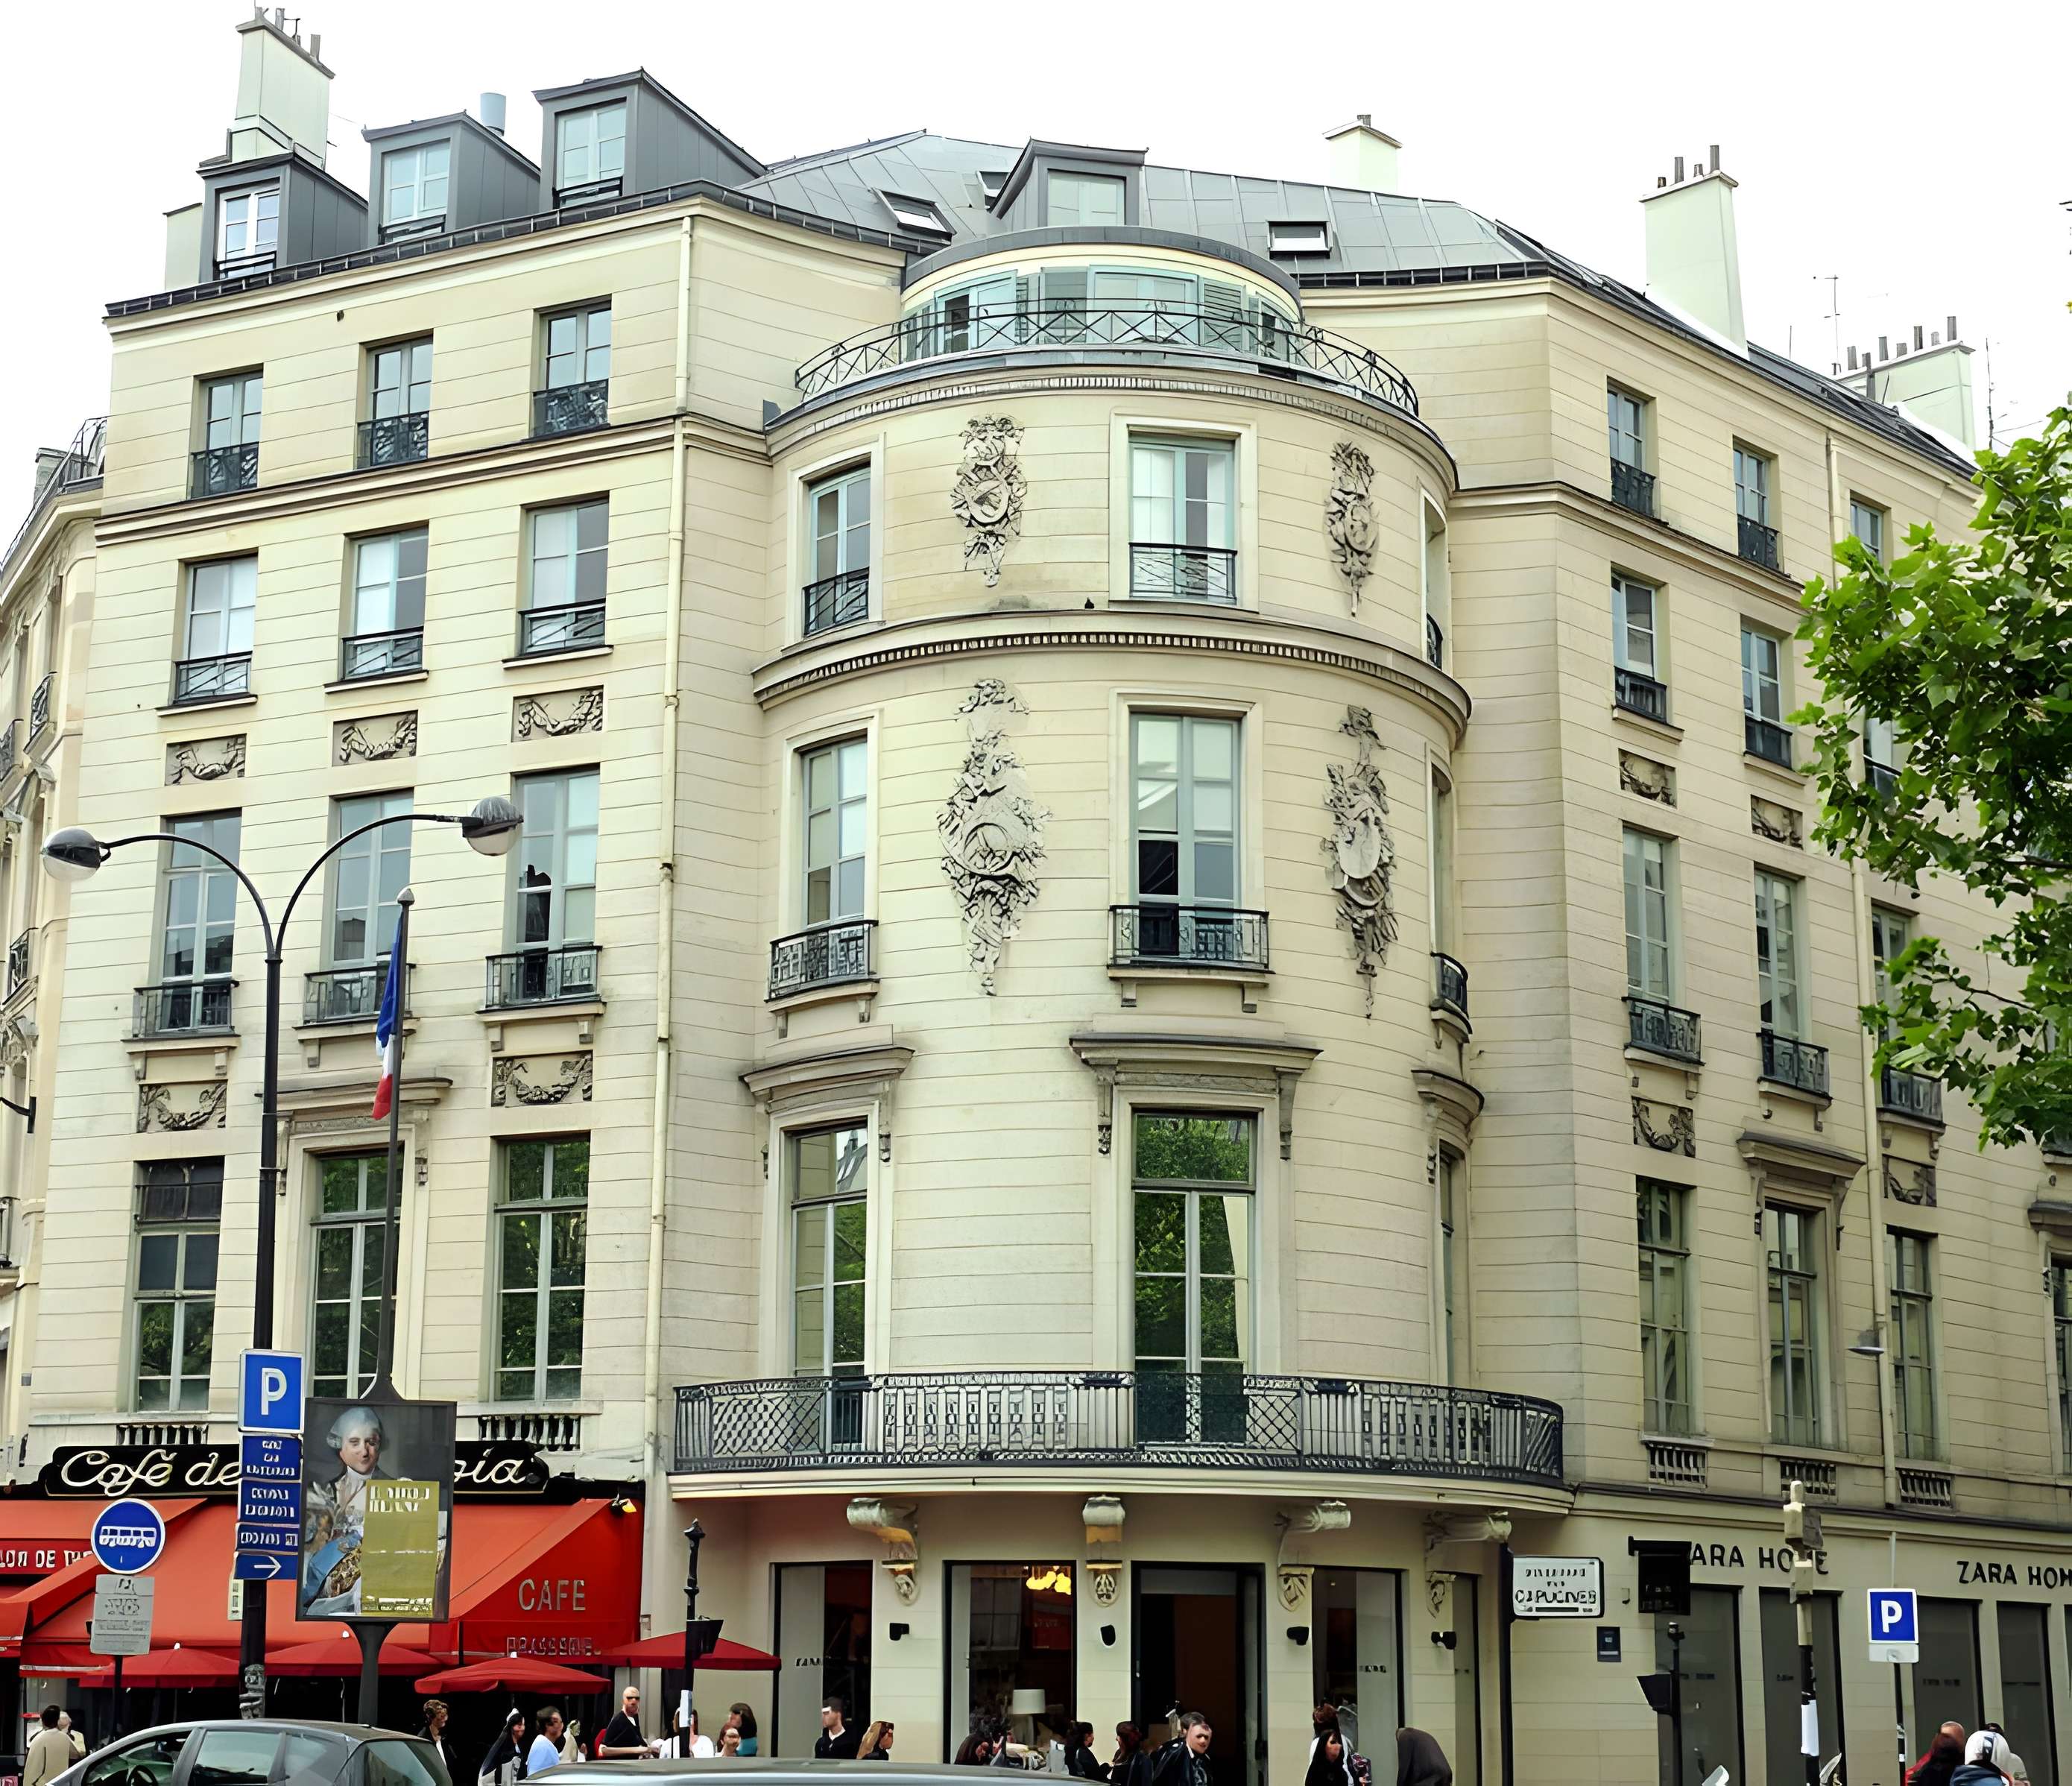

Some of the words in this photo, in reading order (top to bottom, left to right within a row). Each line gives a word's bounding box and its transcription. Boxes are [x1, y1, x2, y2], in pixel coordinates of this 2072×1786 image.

[261, 1367, 288, 1416] P
[60, 1448, 178, 1497] Café
[185, 1452, 240, 1486] de
[1690, 1543, 1745, 1568] ARA
[1758, 1547, 1829, 1575] HOE
[1956, 1561, 2017, 1585] ZARA
[2027, 1566, 2072, 1589] HOM
[1880, 1600, 1903, 1633] P
